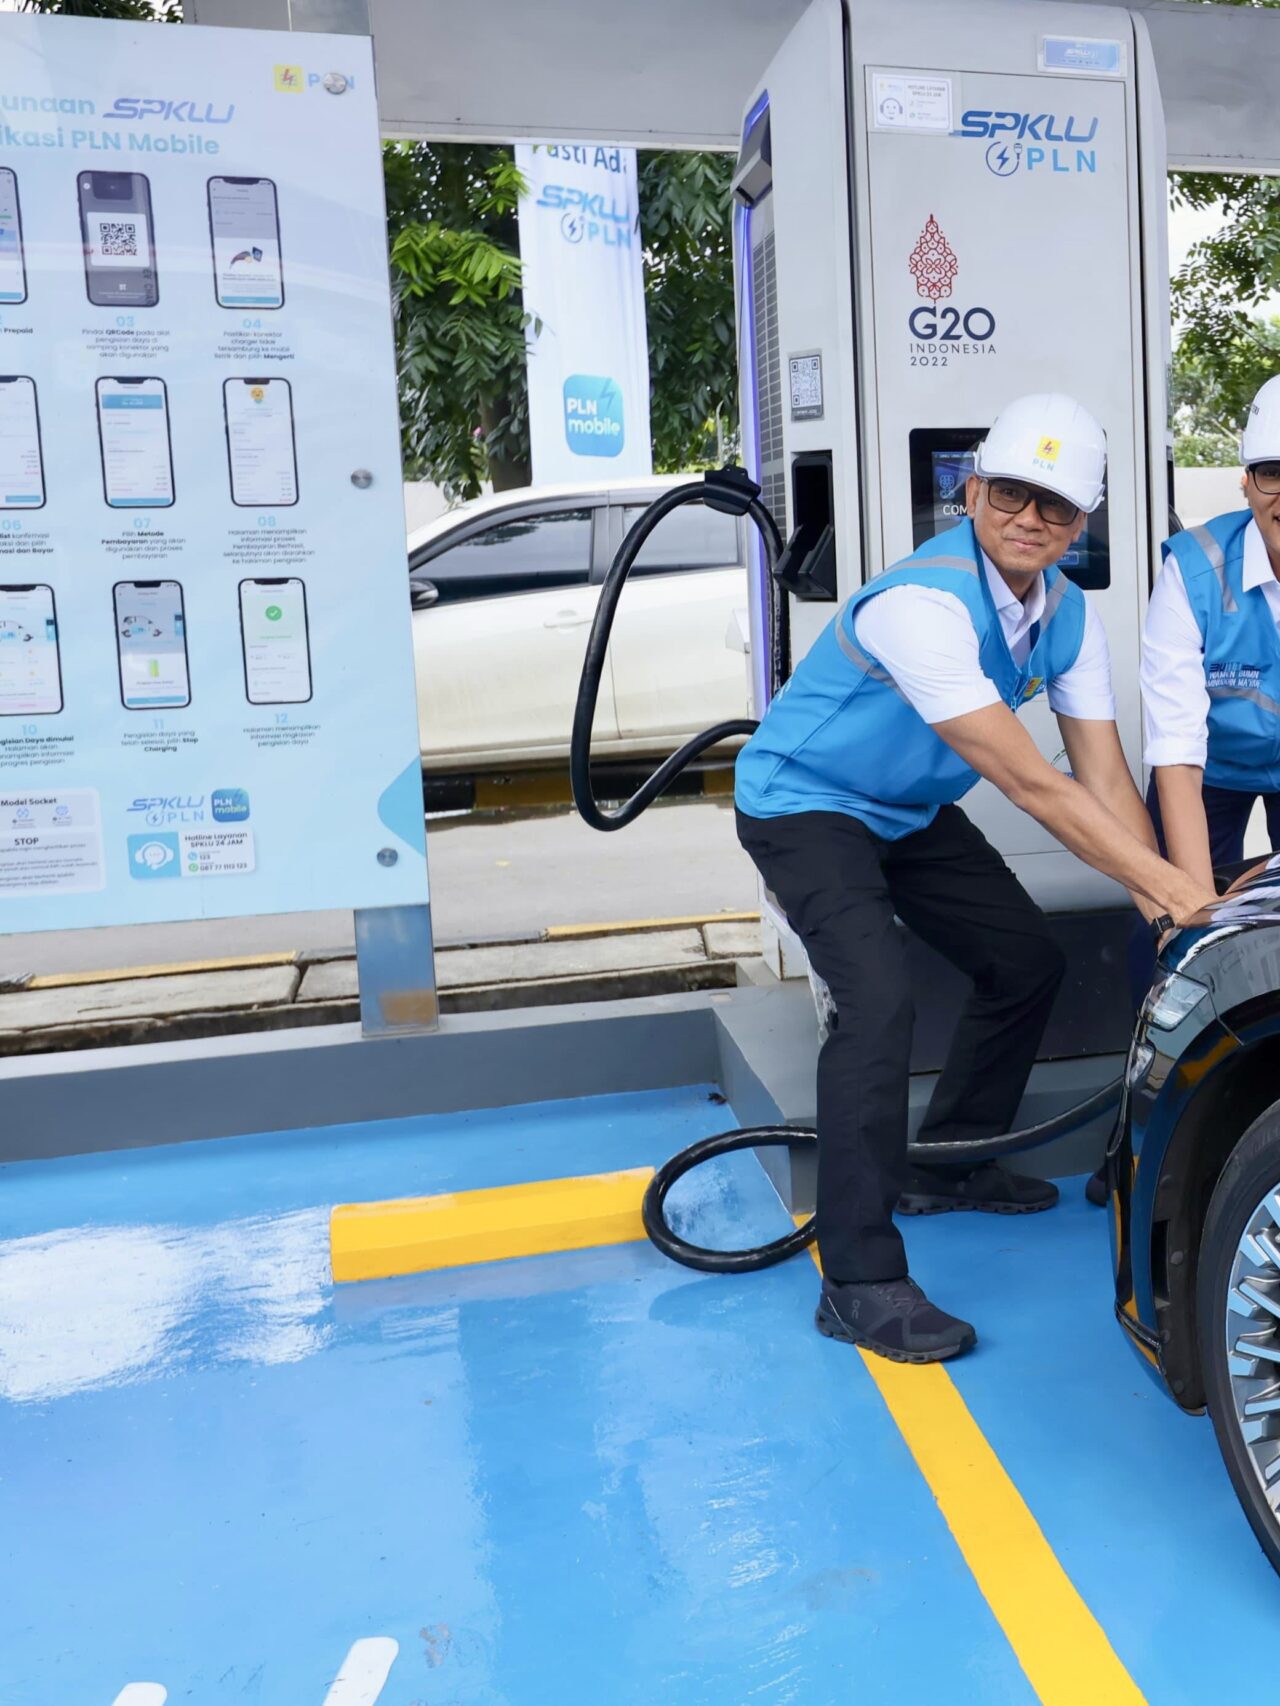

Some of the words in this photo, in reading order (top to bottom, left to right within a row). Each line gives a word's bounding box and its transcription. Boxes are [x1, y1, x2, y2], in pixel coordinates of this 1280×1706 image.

[102, 97, 235, 124] SPKLU
[949, 110, 1098, 142] SPKLU
[71, 130, 121, 150] PLN
[128, 132, 220, 154] Mobile
[1026, 147, 1096, 173] PLN
[536, 184, 630, 223] SPKLU
[588, 221, 632, 249] PLN
[909, 306, 995, 341] G20
[910, 343, 996, 354] INDONESIA
[910, 356, 948, 366] 2022
[567, 397, 598, 415] PLN
[568, 416, 621, 436] mobile
[1032, 458, 1056, 472] PLN
[29, 797, 57, 805] Socket
[127, 796, 204, 811] SPKLU
[214, 798, 232, 806] PLN
[167, 811, 204, 823] PLN
[215, 805, 247, 814] mobile
[14, 837, 39, 846] STOP
